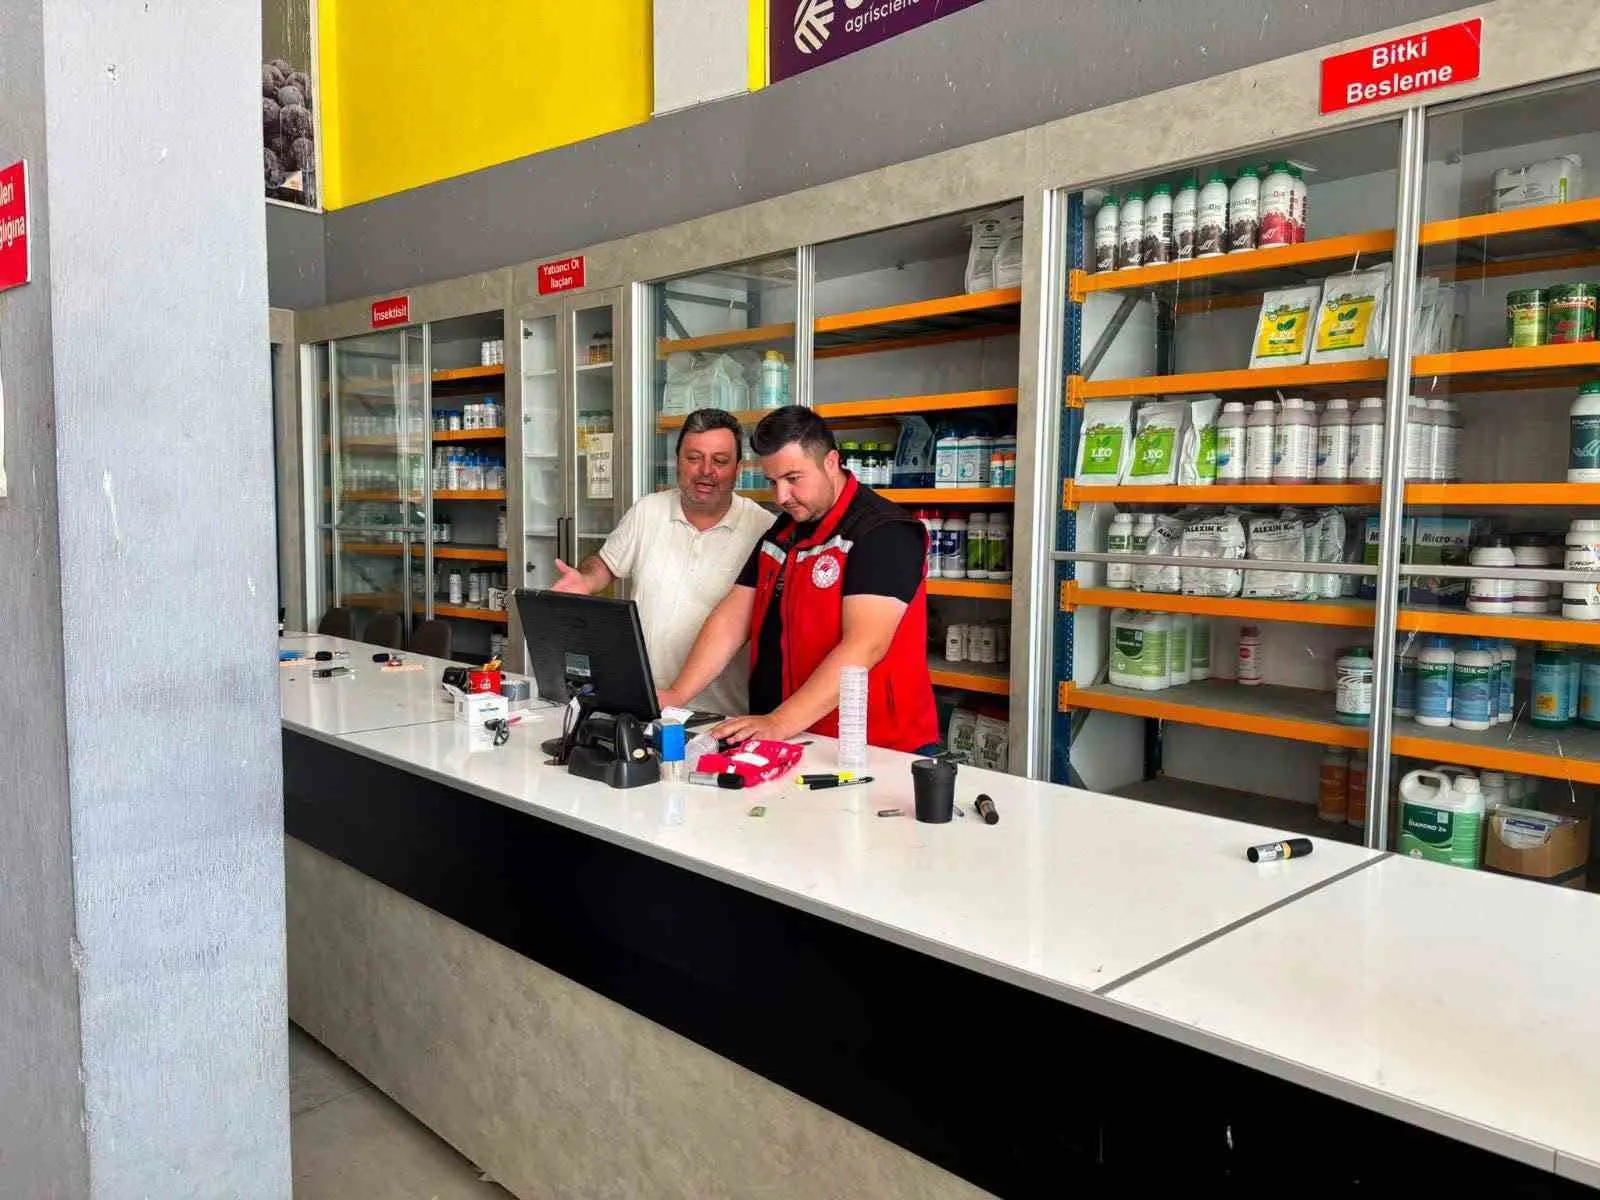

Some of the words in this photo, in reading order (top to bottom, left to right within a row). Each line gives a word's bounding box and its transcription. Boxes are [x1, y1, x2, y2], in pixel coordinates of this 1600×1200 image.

[845, 0, 919, 32] agriscien
[1372, 36, 1427, 69] Bitki
[1347, 65, 1452, 104] Besleme
